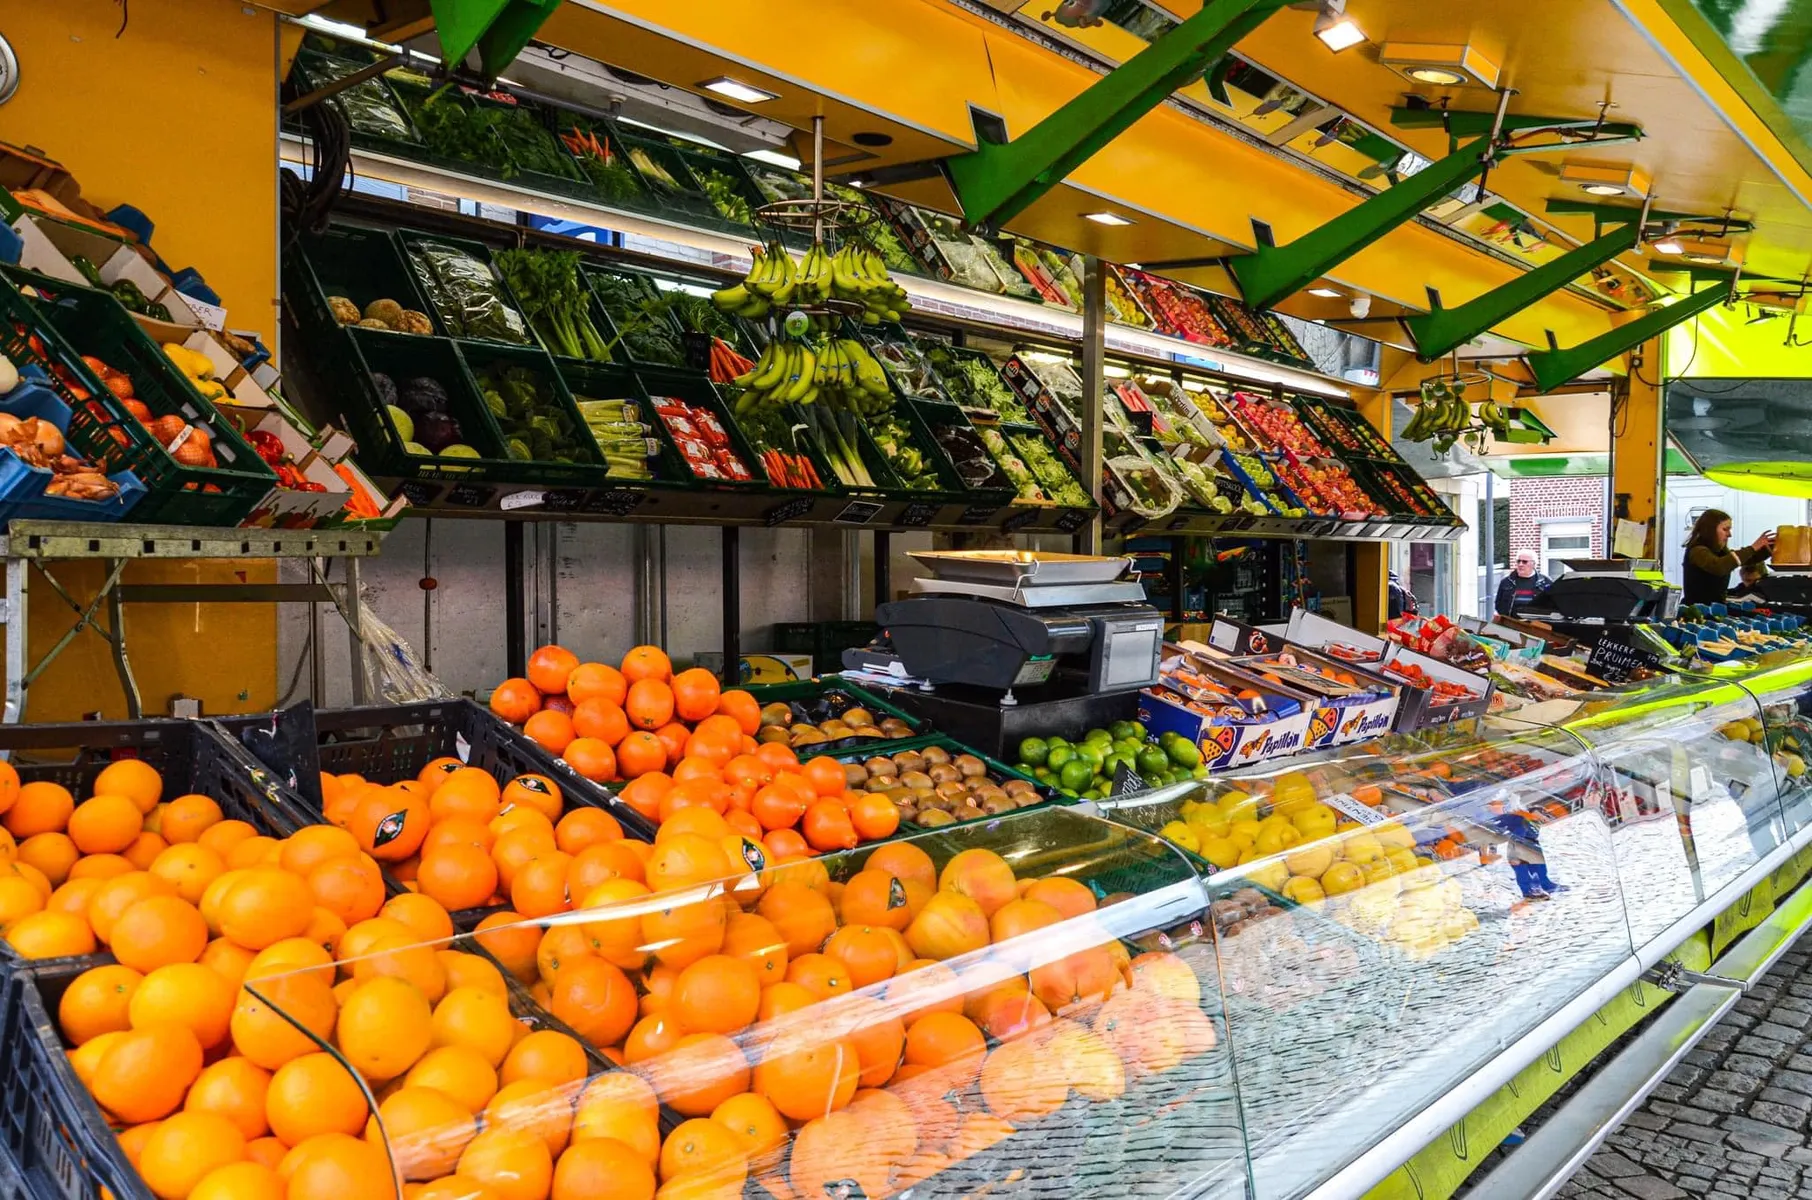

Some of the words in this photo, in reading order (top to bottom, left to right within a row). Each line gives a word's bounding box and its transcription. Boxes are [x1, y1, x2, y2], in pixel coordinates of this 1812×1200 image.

[1598, 638, 1635, 655] LEKKERE
[1357, 714, 1389, 734] Papillon
[1261, 730, 1301, 755] Papillon
